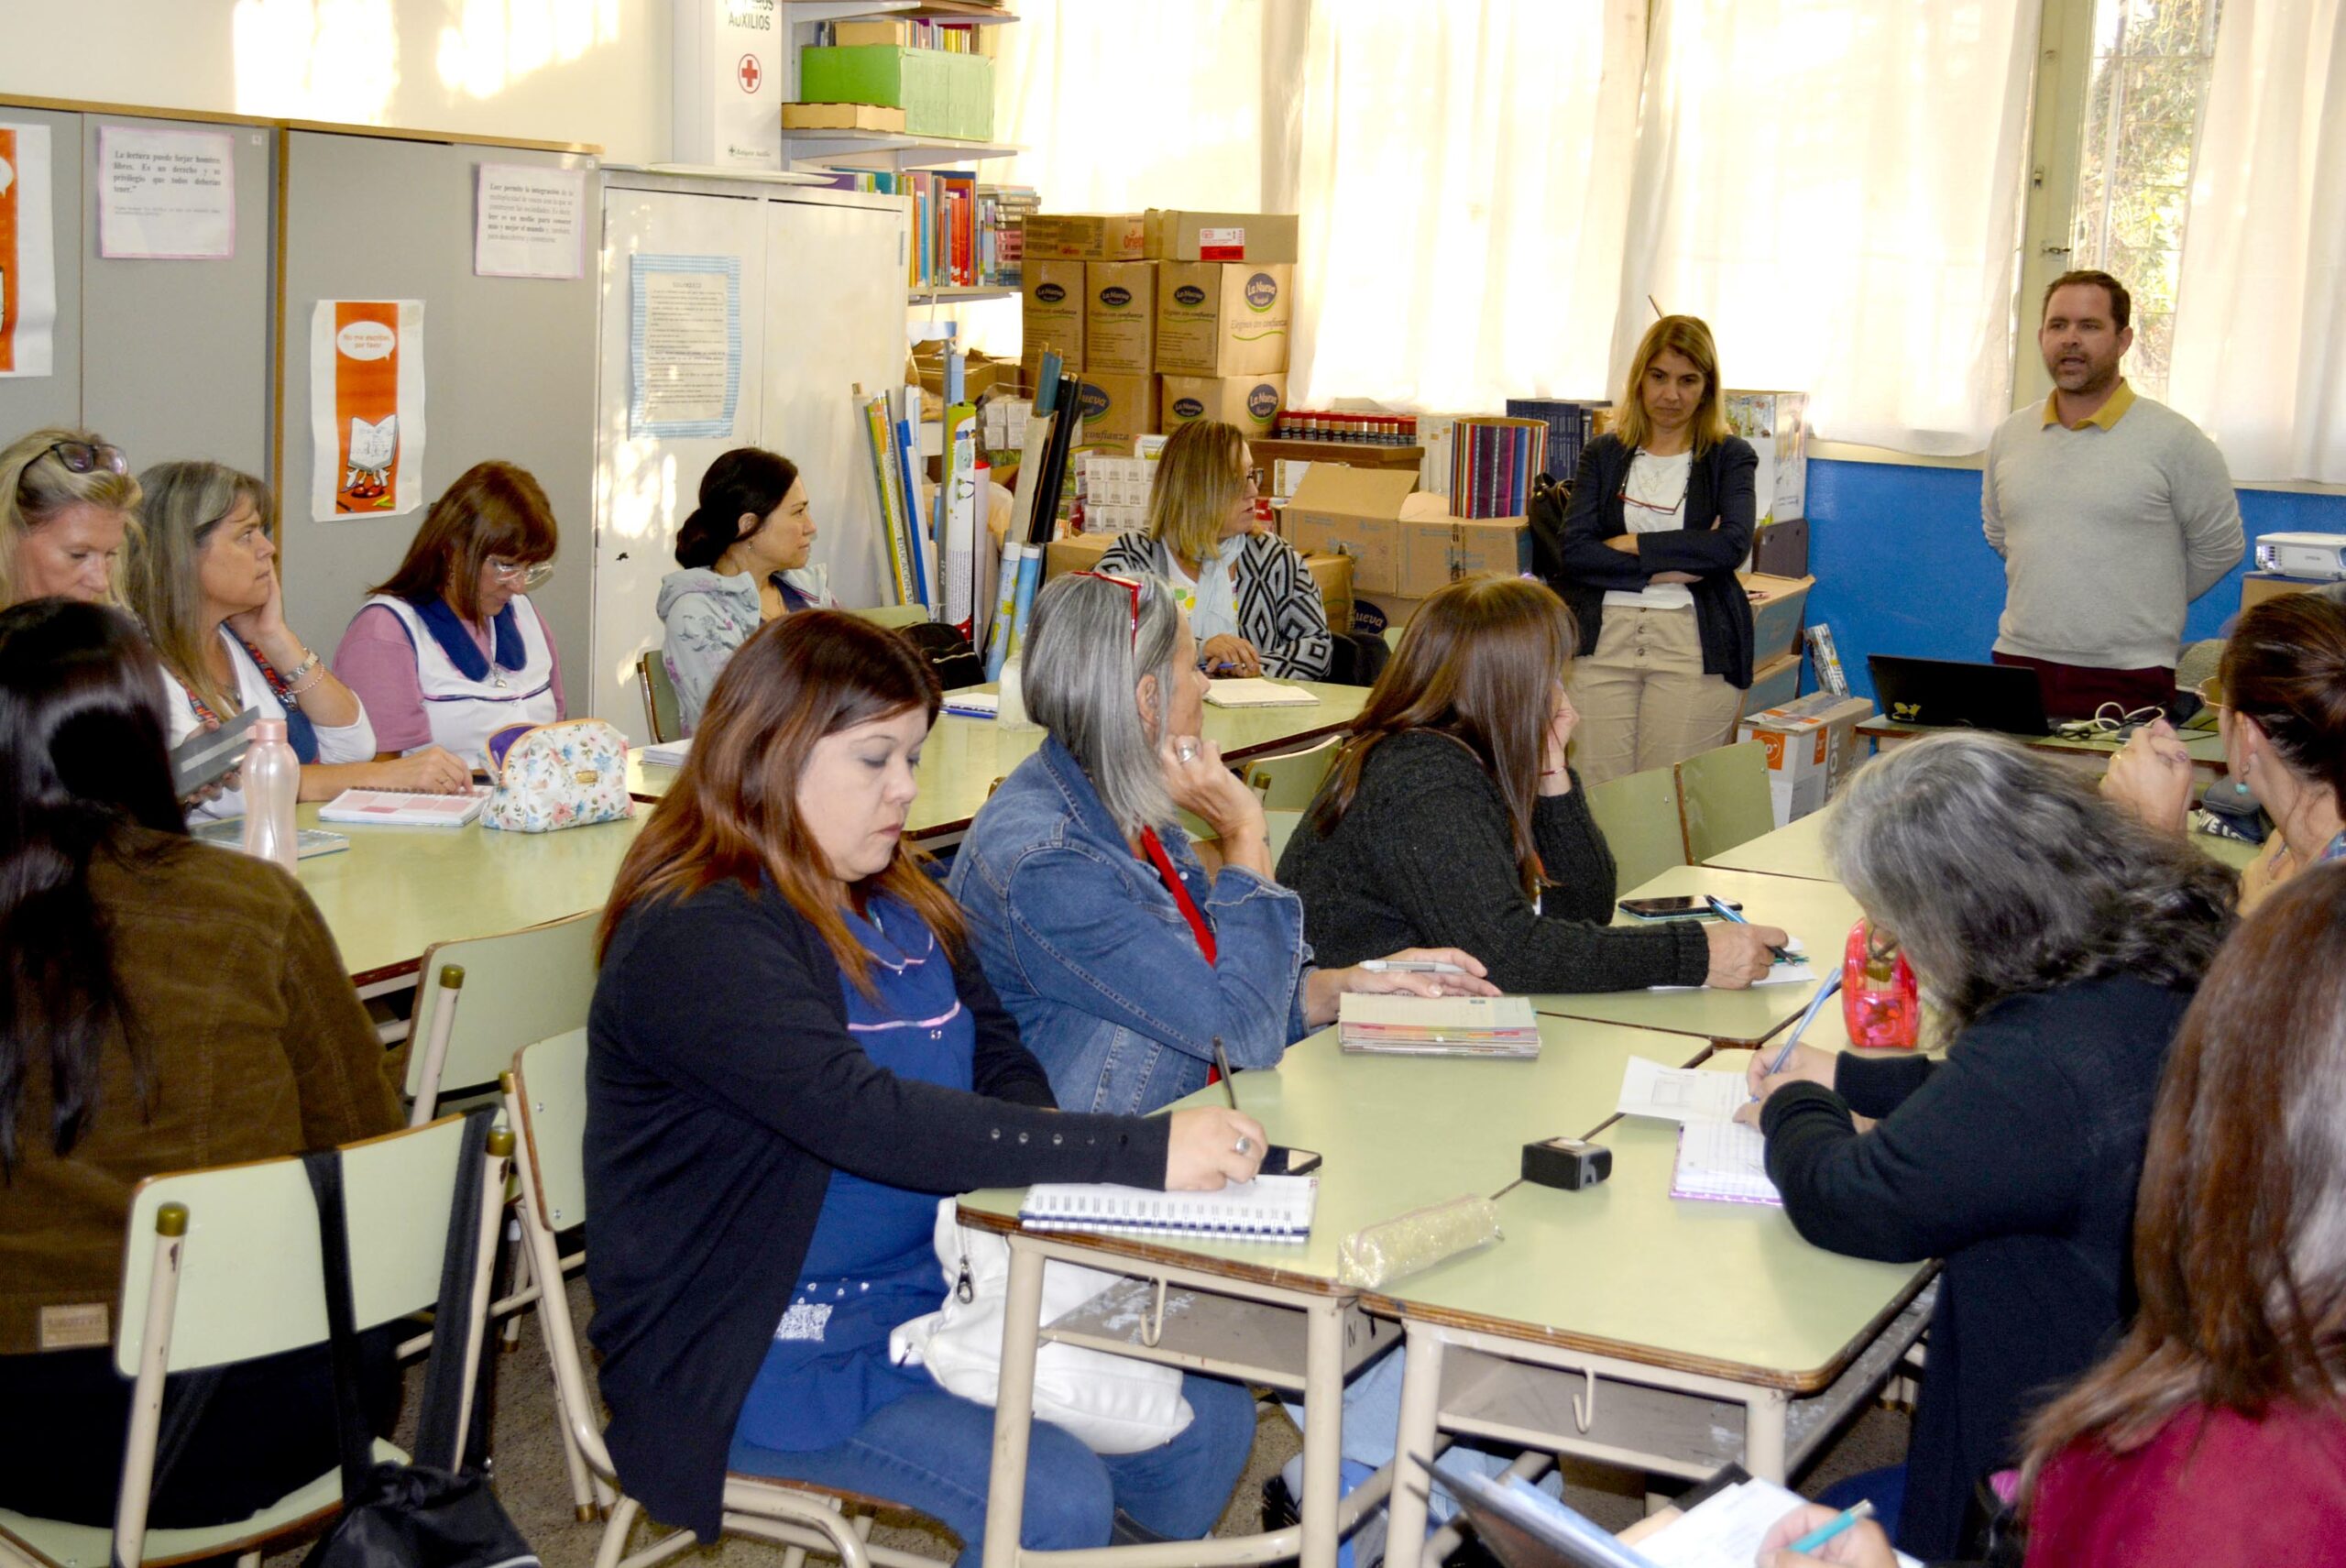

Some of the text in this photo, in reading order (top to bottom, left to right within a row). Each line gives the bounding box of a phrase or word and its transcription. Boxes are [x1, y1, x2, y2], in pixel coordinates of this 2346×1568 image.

[728, 10, 771, 31] AUXILIOS
[1080, 391, 1107, 407] ueva
[1085, 430, 1130, 443] confianza
